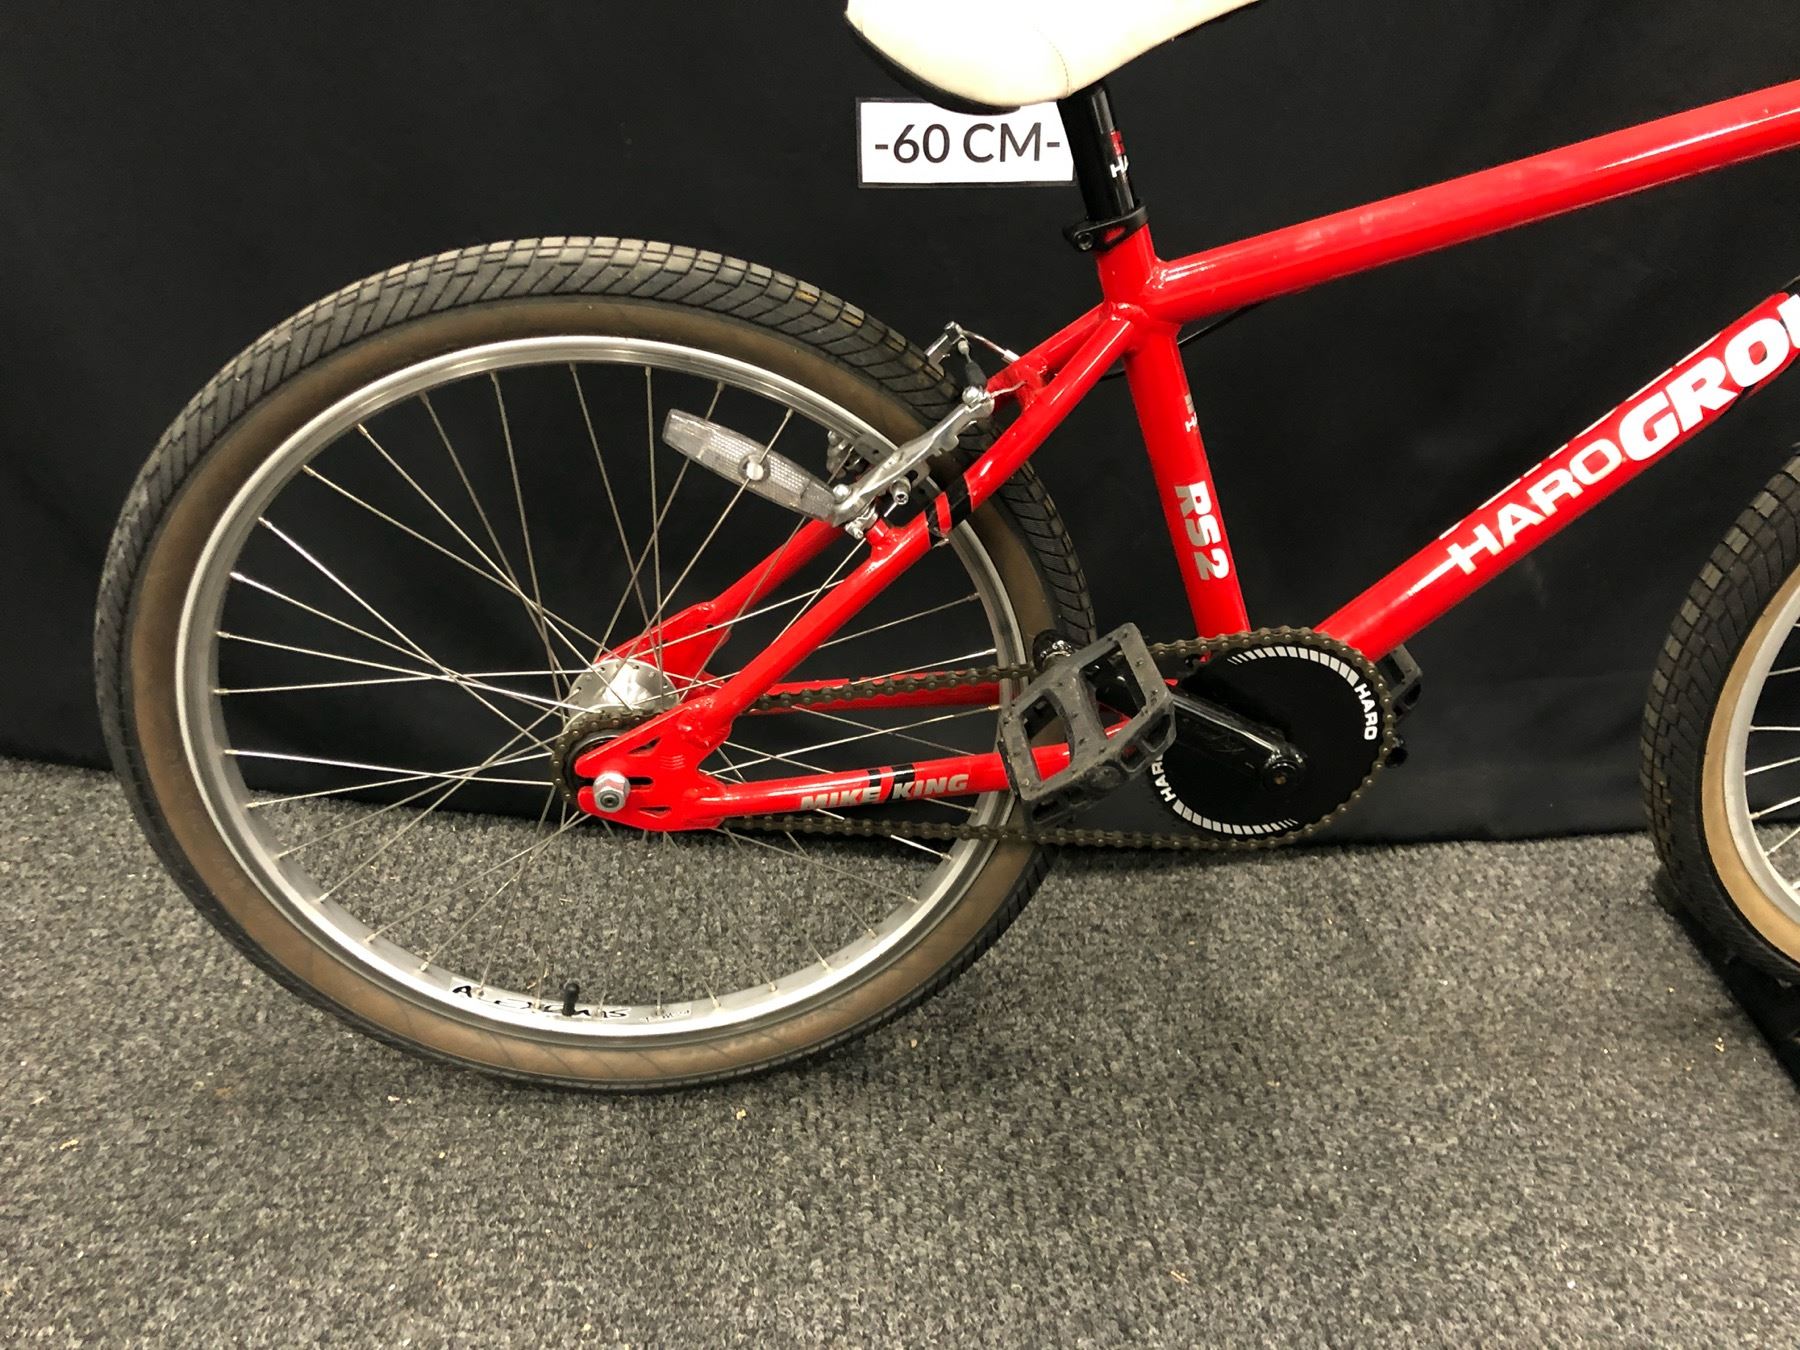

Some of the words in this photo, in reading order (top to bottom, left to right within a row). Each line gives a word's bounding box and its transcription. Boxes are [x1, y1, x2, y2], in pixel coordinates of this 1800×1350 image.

[875, 124, 951, 164] -60
[963, 122, 1060, 162] CM-
[1174, 480, 1229, 581] RS2
[1446, 437, 1623, 576] HARO
[1354, 683, 1379, 741] HARO
[800, 785, 882, 811] MIKE
[892, 773, 970, 800] KING
